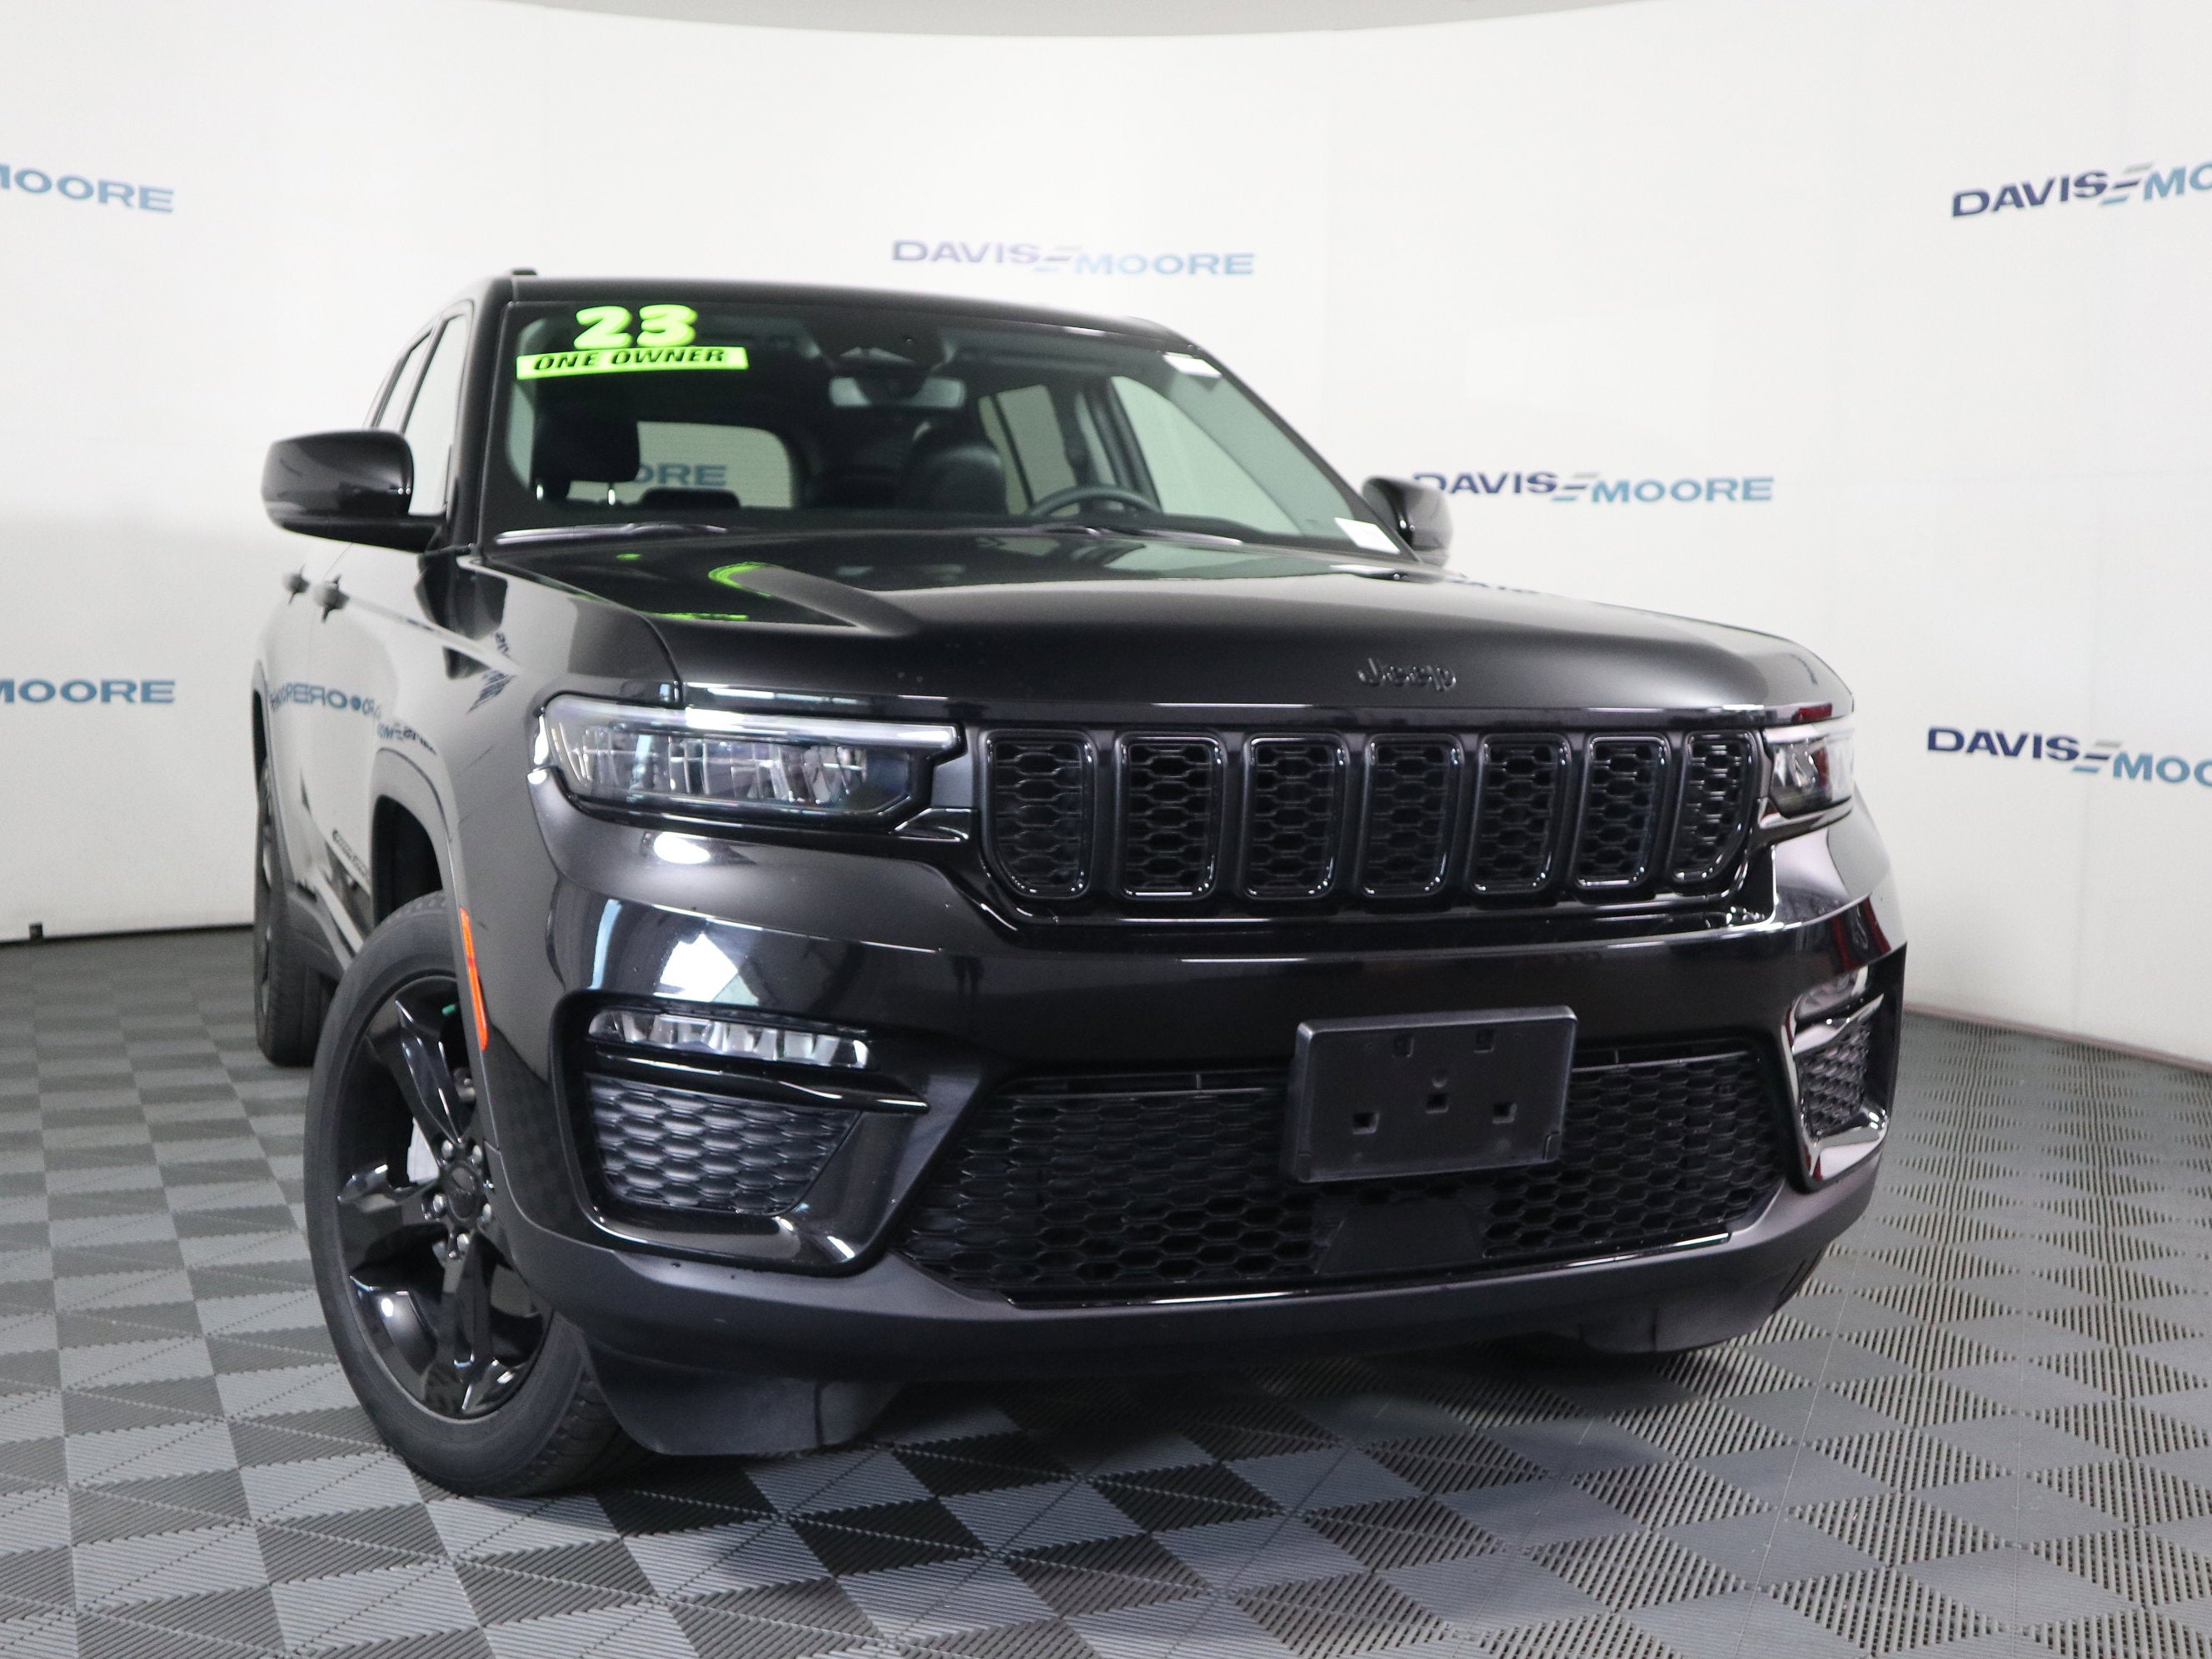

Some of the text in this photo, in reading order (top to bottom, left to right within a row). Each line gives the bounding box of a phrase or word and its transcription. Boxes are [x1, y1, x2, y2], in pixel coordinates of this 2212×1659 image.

[0, 163, 173, 213] OORE
[1951, 169, 2108, 218] DAVIS
[892, 239, 1255, 276] DAVIS MOORE
[573, 304, 698, 349] 23
[534, 349, 725, 371] ONE OWNER
[1592, 476, 1774, 503] MOORE
[1357, 657, 1457, 692] Jeep
[1927, 727, 2080, 761] DAVIS
